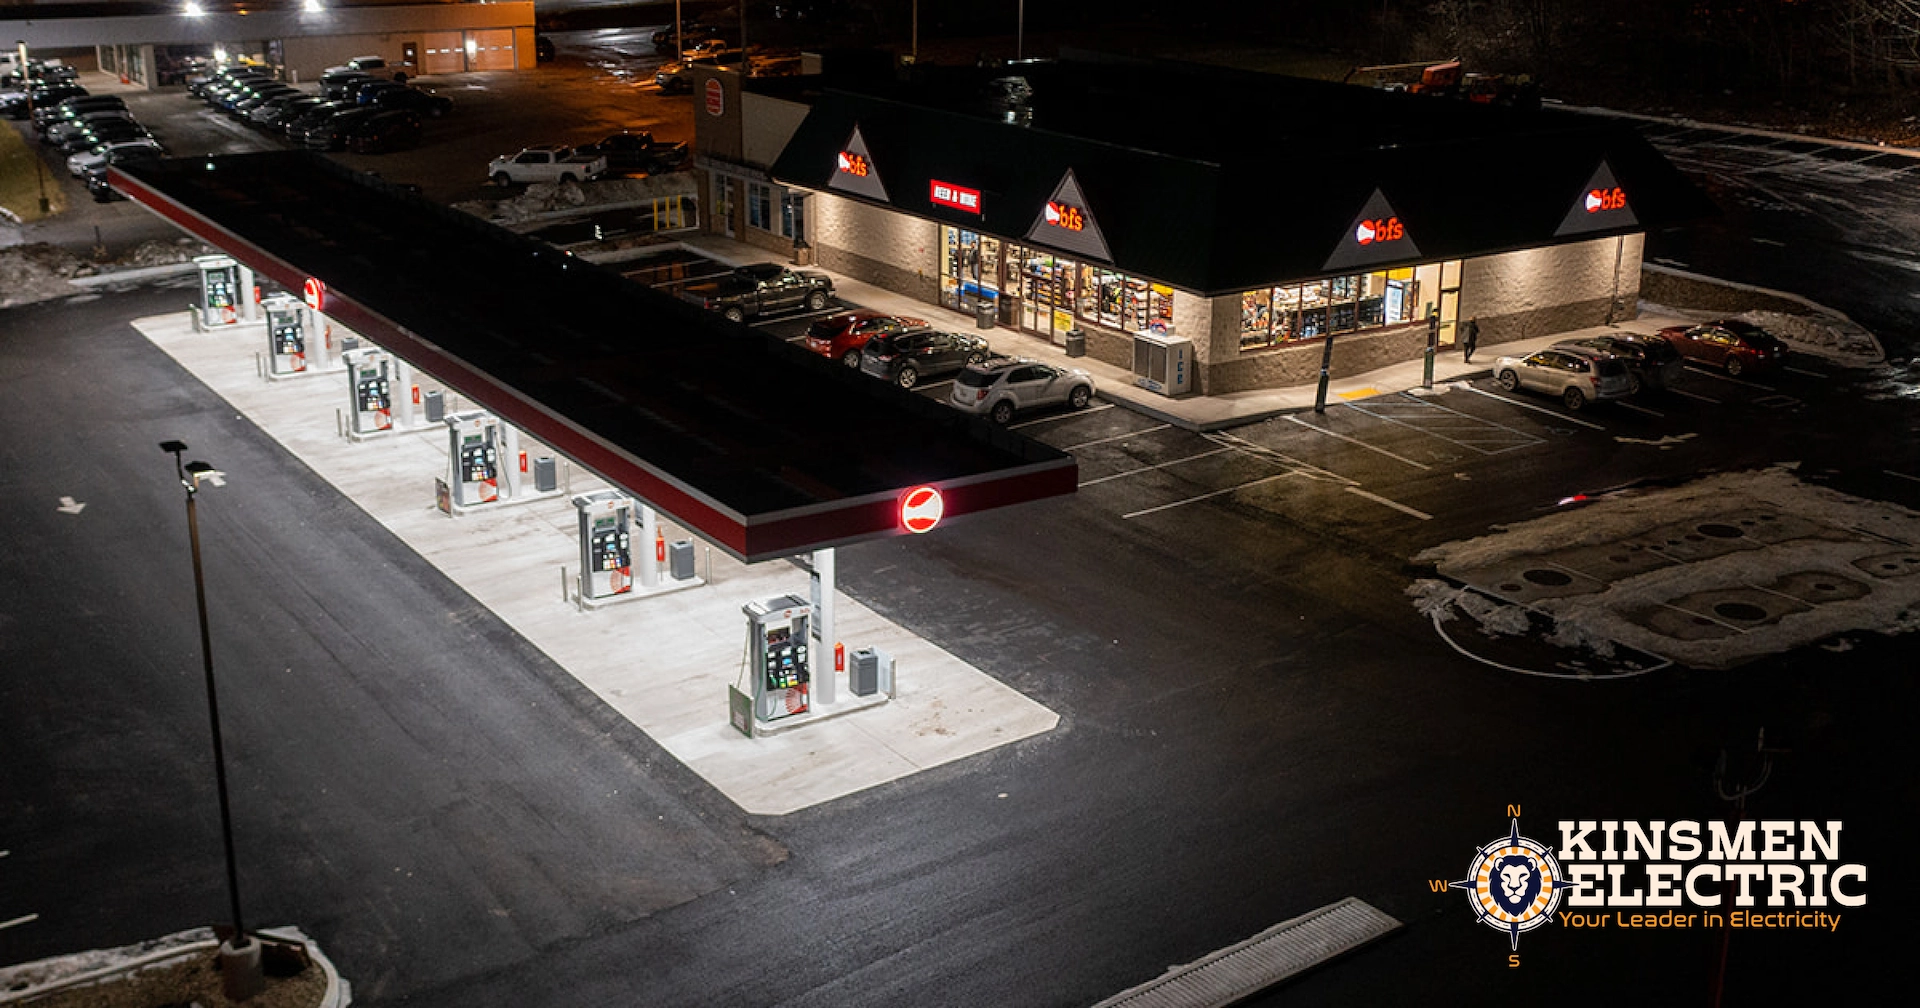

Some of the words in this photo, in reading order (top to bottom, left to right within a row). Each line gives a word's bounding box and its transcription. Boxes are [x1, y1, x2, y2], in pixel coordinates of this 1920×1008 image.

[849, 154, 867, 177] bfs
[1602, 187, 1626, 210] bfs
[1059, 205, 1082, 232] bfs
[1374, 217, 1403, 242] bfs
